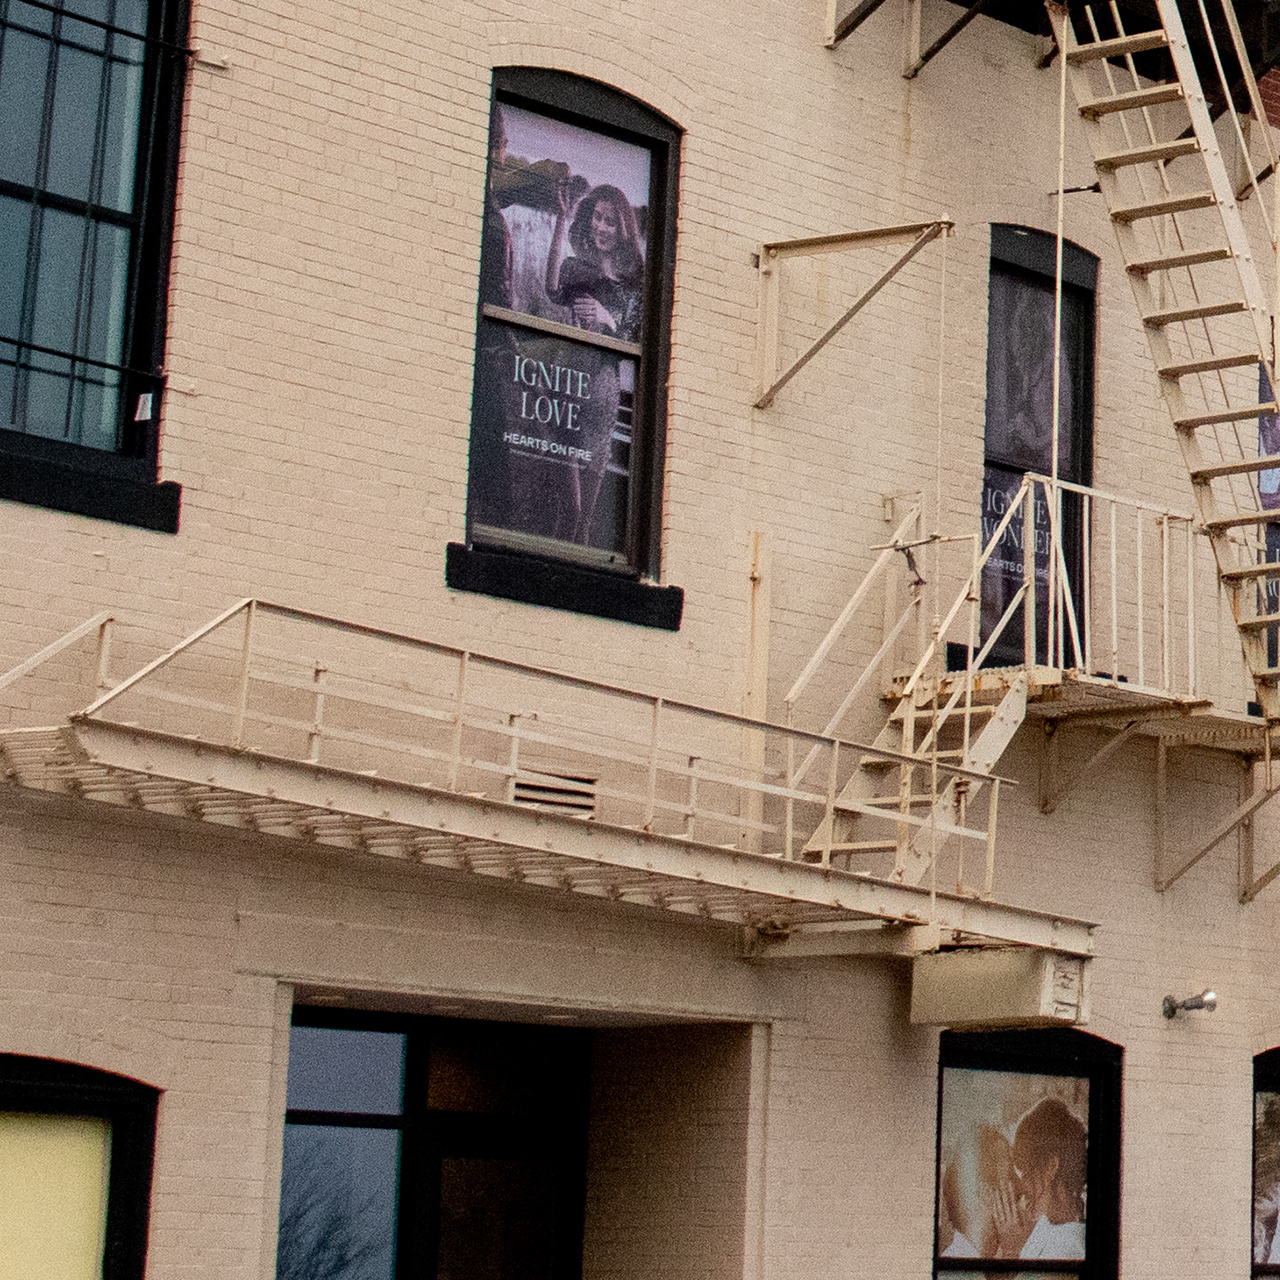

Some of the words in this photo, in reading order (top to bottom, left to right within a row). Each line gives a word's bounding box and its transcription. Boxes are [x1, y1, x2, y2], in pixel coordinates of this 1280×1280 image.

[514, 355, 591, 400] IGNITE
[521, 392, 581, 431] LOVE
[503, 431, 549, 452] HEARTS
[549, 443, 567, 456] ON
[568, 447, 593, 462] FIRE
[987, 488, 1047, 525] IGNIE
[982, 517, 1051, 555] ONE
